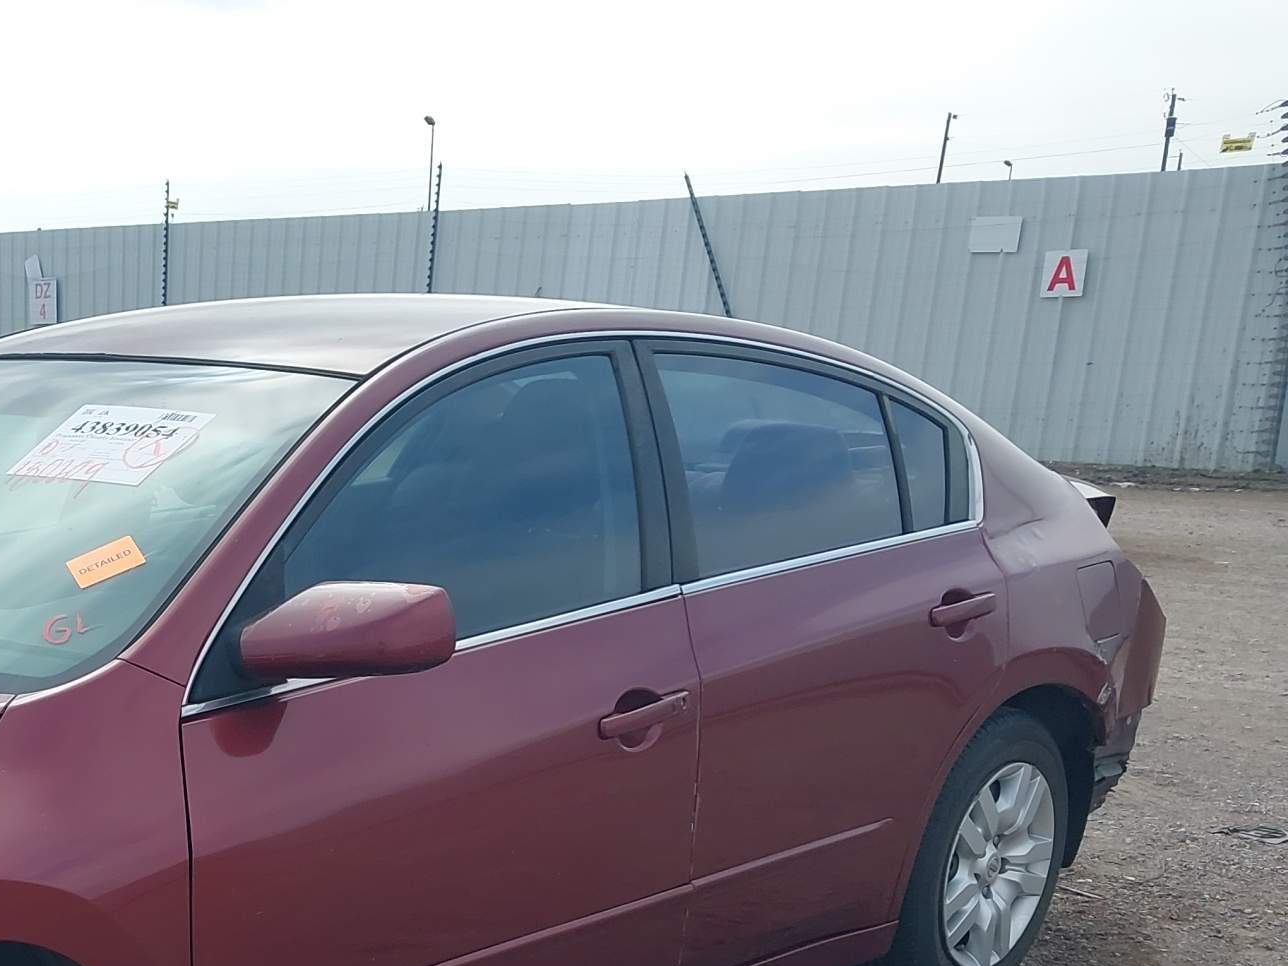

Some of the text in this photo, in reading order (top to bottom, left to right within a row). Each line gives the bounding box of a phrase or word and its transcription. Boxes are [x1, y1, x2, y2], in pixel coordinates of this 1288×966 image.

[1047, 255, 1076, 291] A
[39, 303, 46, 320] 4
[71, 420, 180, 439] 43839054
[79, 549, 132, 575] DETAILED
